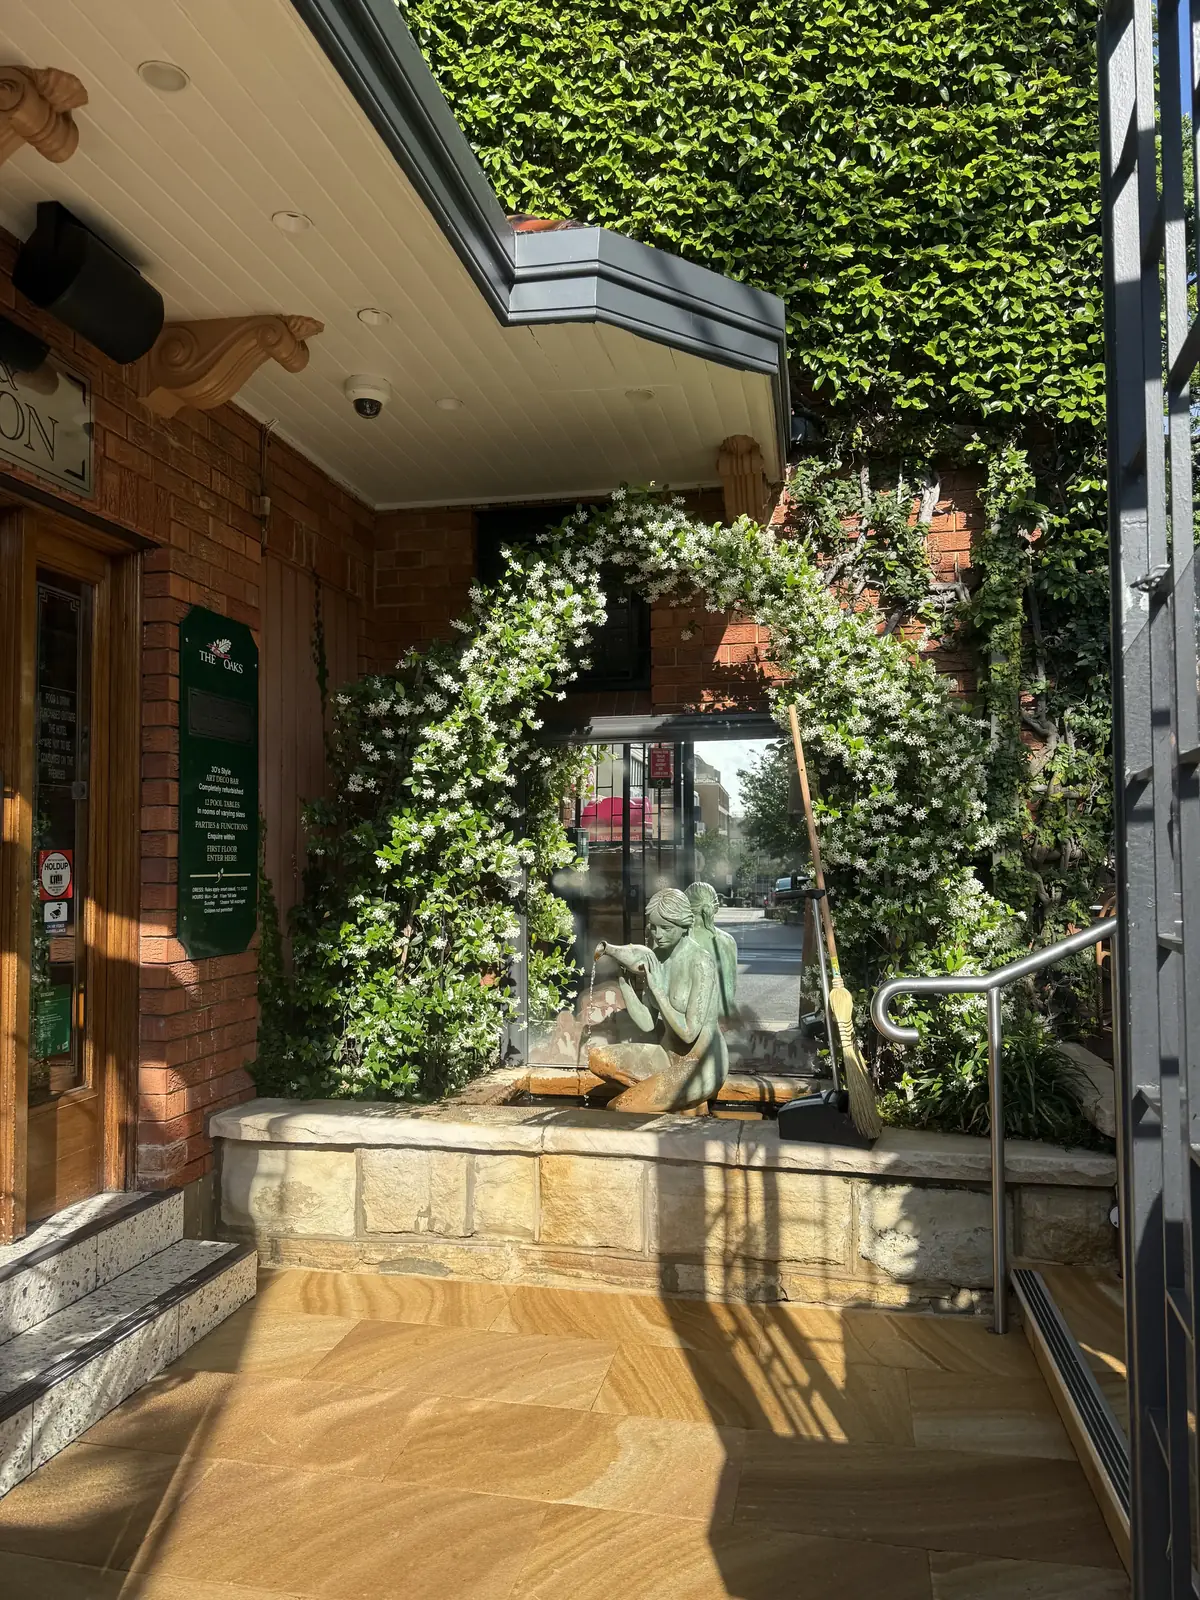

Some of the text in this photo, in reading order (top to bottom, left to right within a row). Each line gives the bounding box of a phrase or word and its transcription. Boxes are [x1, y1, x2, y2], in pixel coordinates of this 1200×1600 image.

[199, 650, 244, 674] THE OAKS
[221, 767, 231, 776] Style
[206, 774, 239, 785] ART DECO BAR
[198, 782, 244, 795] Completely refurbished
[210, 798, 223, 807] POOL
[224, 800, 240, 809] TABLES
[221, 811, 235, 819] varying
[195, 820, 216, 829] PARTIES
[220, 822, 248, 831] FUNCTIONS
[207, 832, 223, 841] Enquire
[207, 845, 221, 853] FIRST
[44, 862, 68, 871] HOLDUP
